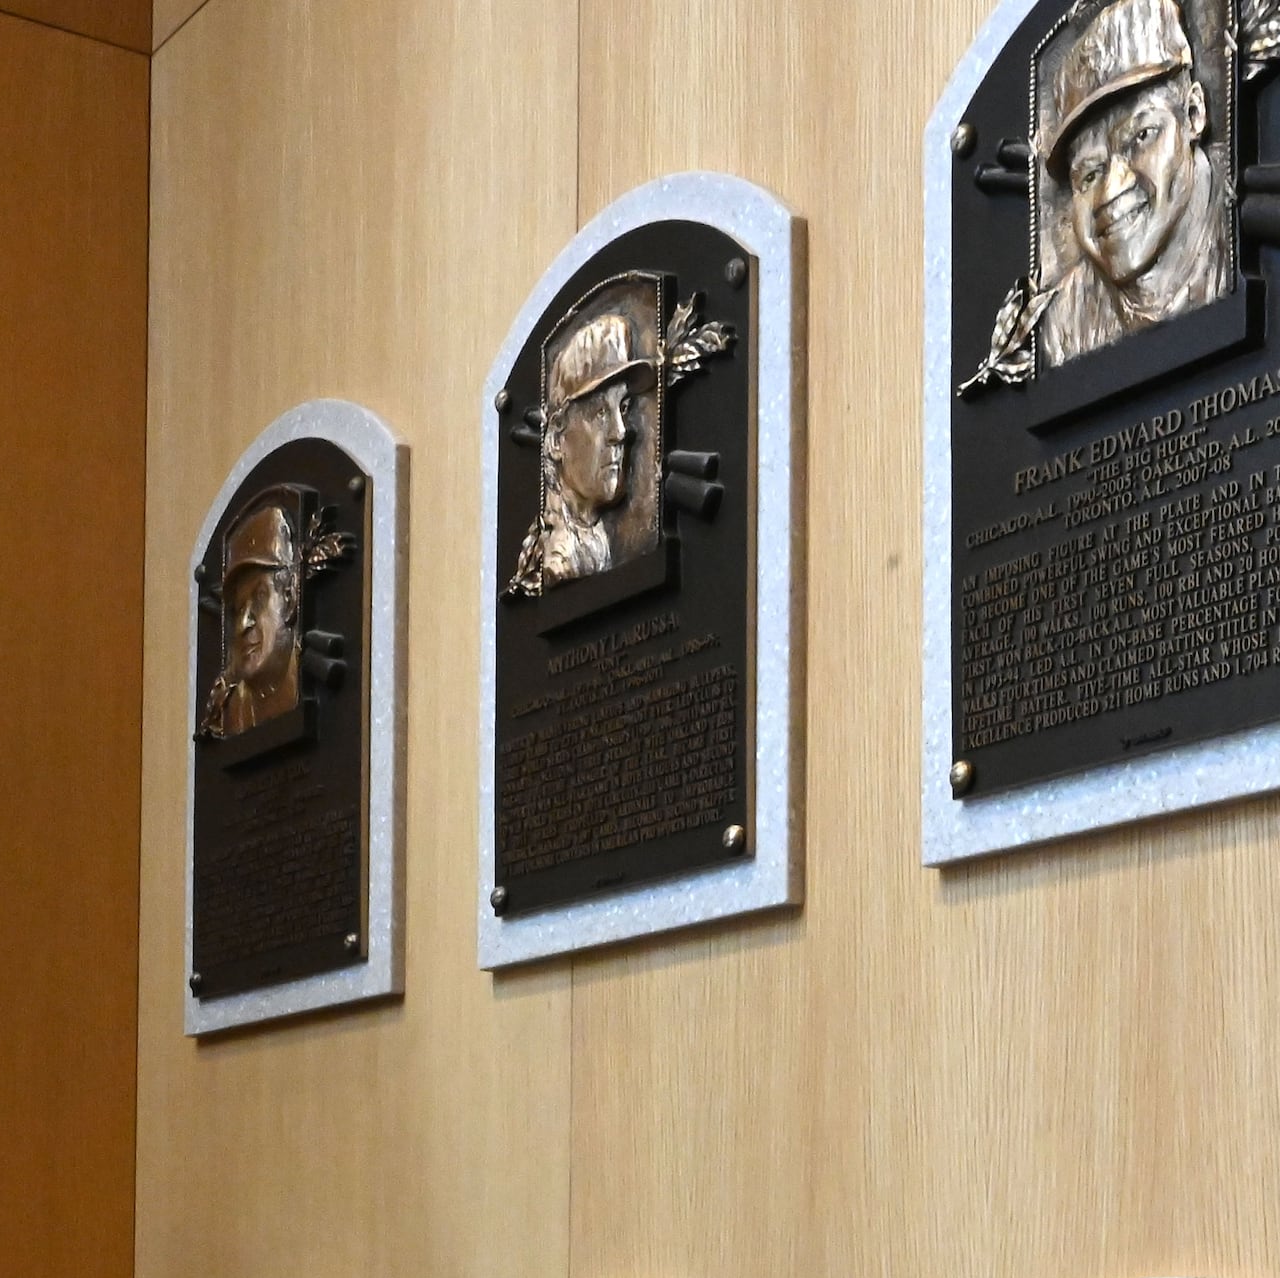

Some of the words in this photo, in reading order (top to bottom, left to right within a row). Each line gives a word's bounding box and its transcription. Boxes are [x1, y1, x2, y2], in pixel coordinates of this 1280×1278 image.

[1015, 446, 1081, 493] FRANK
[1089, 405, 1181, 464] EDWARD
[1124, 447, 1150, 472] BIG
[1157, 426, 1206, 459] HURT"
[1140, 436, 1223, 484] OAKLAND,
[984, 550, 1039, 584] IMPOSING
[1047, 531, 1093, 562] FIGURE
[1103, 522, 1119, 542] AT
[1125, 511, 1149, 534] THE
[1159, 492, 1200, 523] PLATE
[1211, 479, 1238, 504] AND
[1249, 469, 1265, 491] IN
[1064, 487, 1136, 529] TORONTO,
[1140, 475, 1169, 501] A.L.
[1176, 452, 1231, 488] 2007-08
[961, 576, 1017, 611] COMBINED
[1023, 552, 1085, 590] POWERFUL
[1090, 536, 1129, 566] SWING
[1135, 525, 1161, 551] AND
[1167, 491, 1258, 540] EXCEPTIONAL
[1031, 581, 1055, 604] ONE
[1061, 574, 1075, 594] OF
[1084, 563, 1107, 587] THE
[1168, 531, 1200, 559] MOST
[1209, 509, 1263, 545] FEARED
[1090, 601, 1106, 622] 100
[1153, 579, 1172, 602] 100
[1177, 570, 1200, 594] RBI
[1206, 560, 1233, 585] AND
[1238, 553, 1252, 574] 20
[997, 613, 1013, 633] OF
[1022, 603, 1041, 625] HIS
[1051, 589, 1084, 616] FIRST
[1093, 573, 1134, 602] SEVEN
[1145, 558, 1178, 585] FULL
[1089, 639, 1102, 660] IN
[1171, 592, 1257, 635] PERCENTAGE
[1140, 598, 1173, 625] MOST
[1177, 576, 1244, 613] VALUABLE
[1031, 669, 1066, 695] TIMES
[1070, 661, 1094, 684] AND
[1098, 643, 1154, 676] CLAIMED
[1159, 625, 1214, 658] BATTING
[1217, 612, 1257, 640] TITLE
[1262, 606, 1276, 627] IN
[1076, 666, 1140, 700] FIVE-TIME
[1219, 628, 1267, 659] WHOSE
[1034, 697, 1099, 731] PRODUCED
[1124, 679, 1160, 706] HOME
[1164, 668, 1198, 694] RUNS
[1201, 660, 1230, 684] AND
